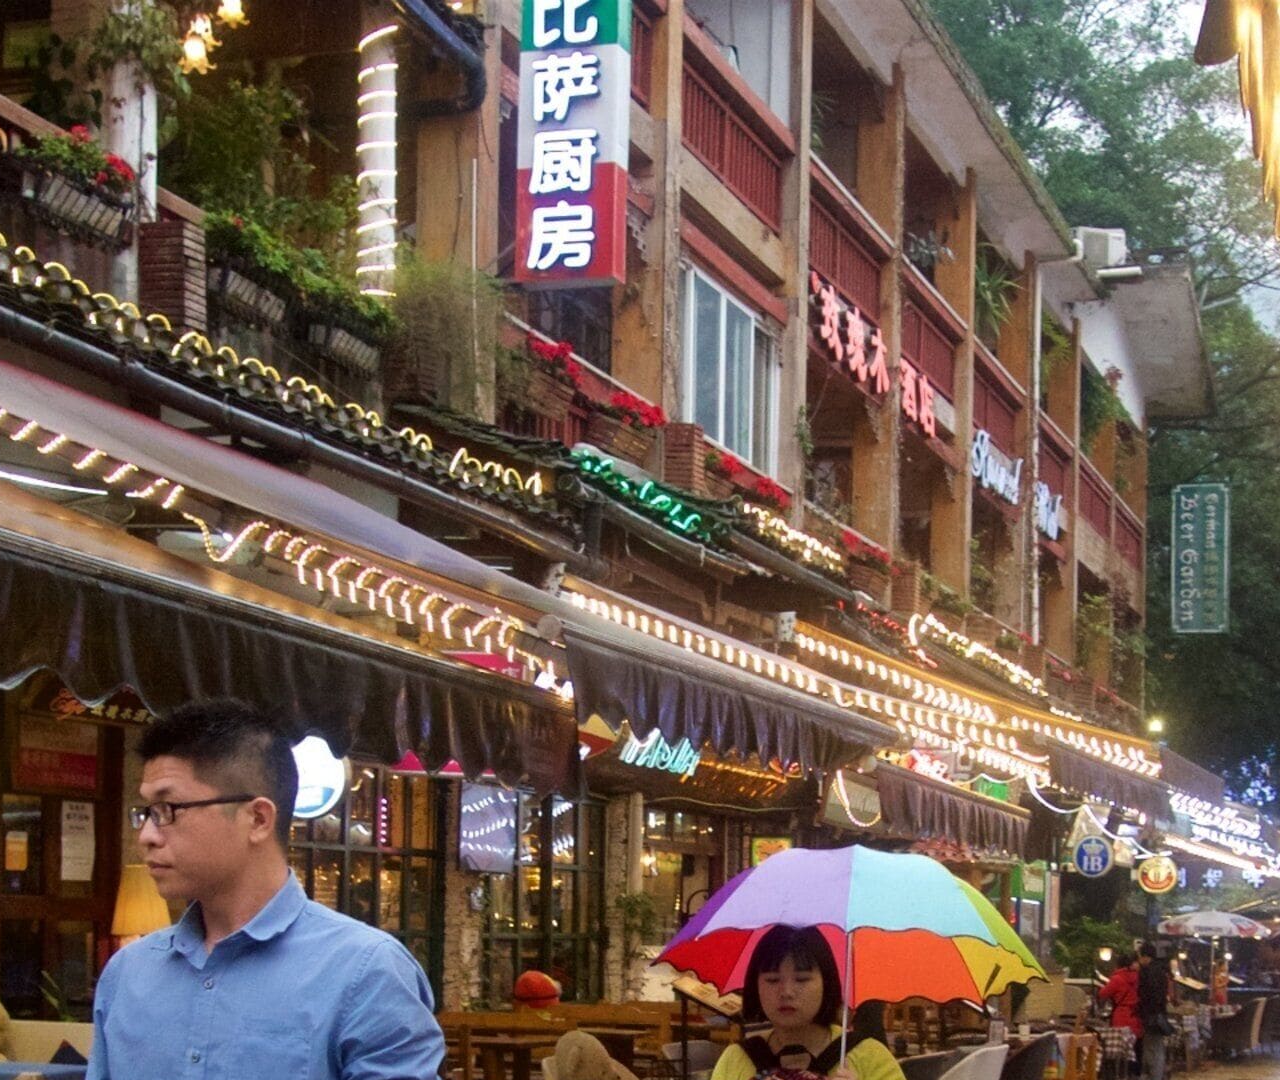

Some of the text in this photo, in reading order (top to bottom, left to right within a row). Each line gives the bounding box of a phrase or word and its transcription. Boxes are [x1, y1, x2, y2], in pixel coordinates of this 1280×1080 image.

[527, 0, 598, 270] 比萨厨房
[1180, 493, 1200, 542] Beer
